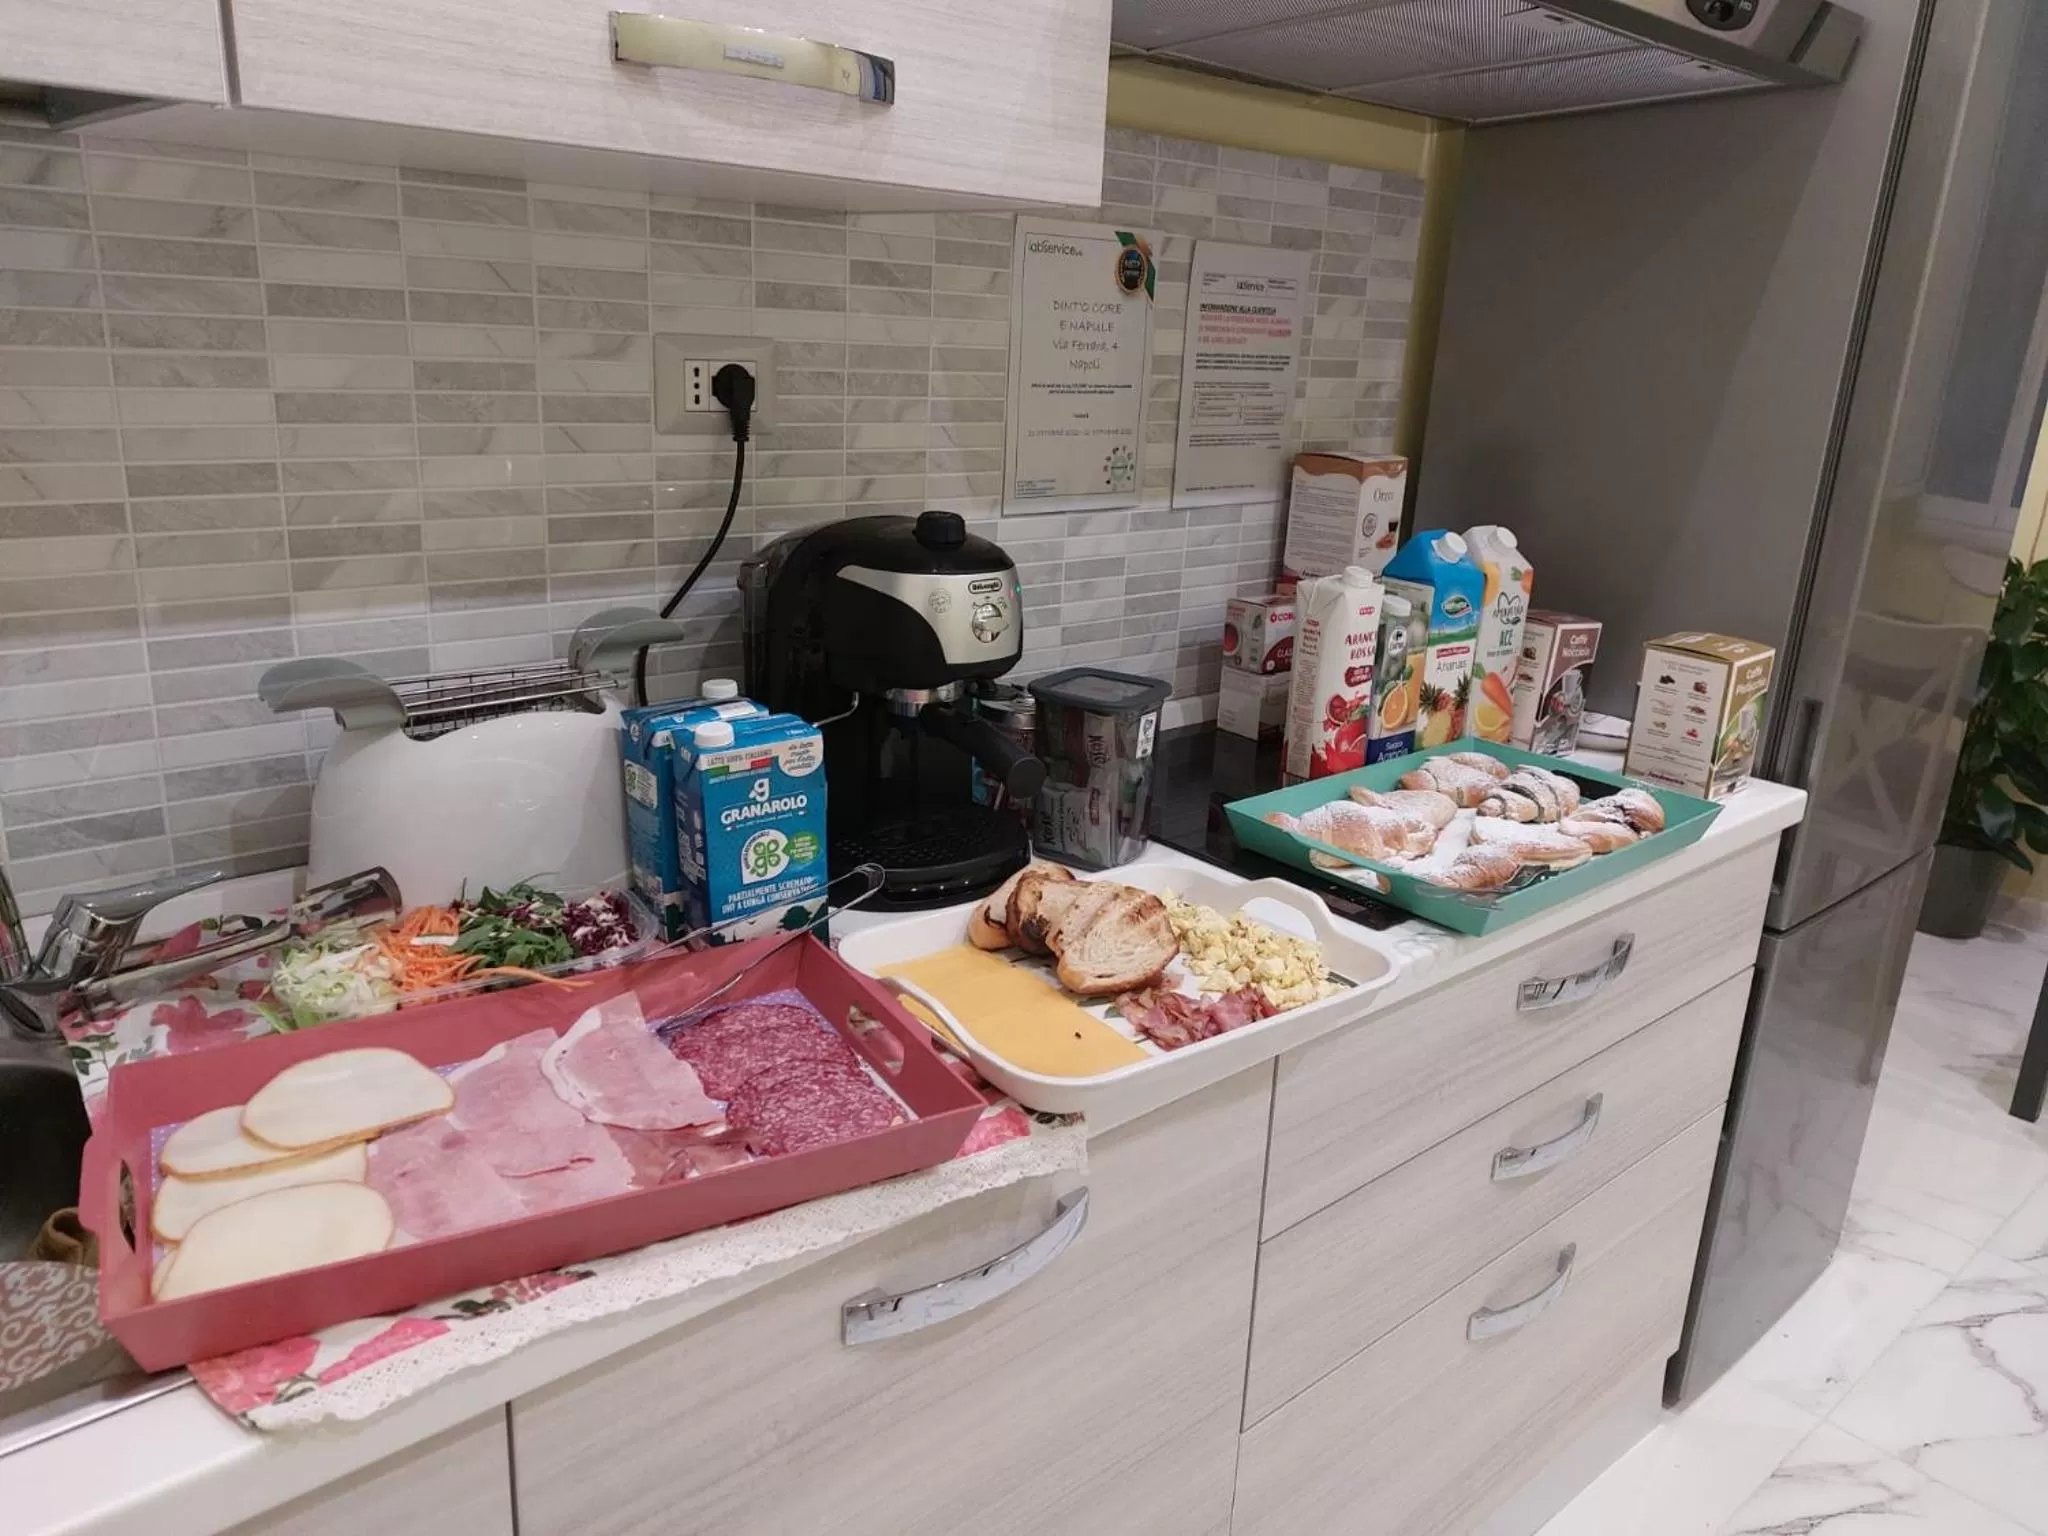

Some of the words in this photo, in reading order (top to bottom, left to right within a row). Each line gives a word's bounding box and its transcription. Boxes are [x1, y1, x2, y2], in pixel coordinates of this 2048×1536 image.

[1069, 320, 1115, 332] NAPULE
[1070, 358, 1100, 374] Napoli
[721, 795, 808, 824] GRANAROLO
[728, 883, 777, 904] PARZIALMENTE
